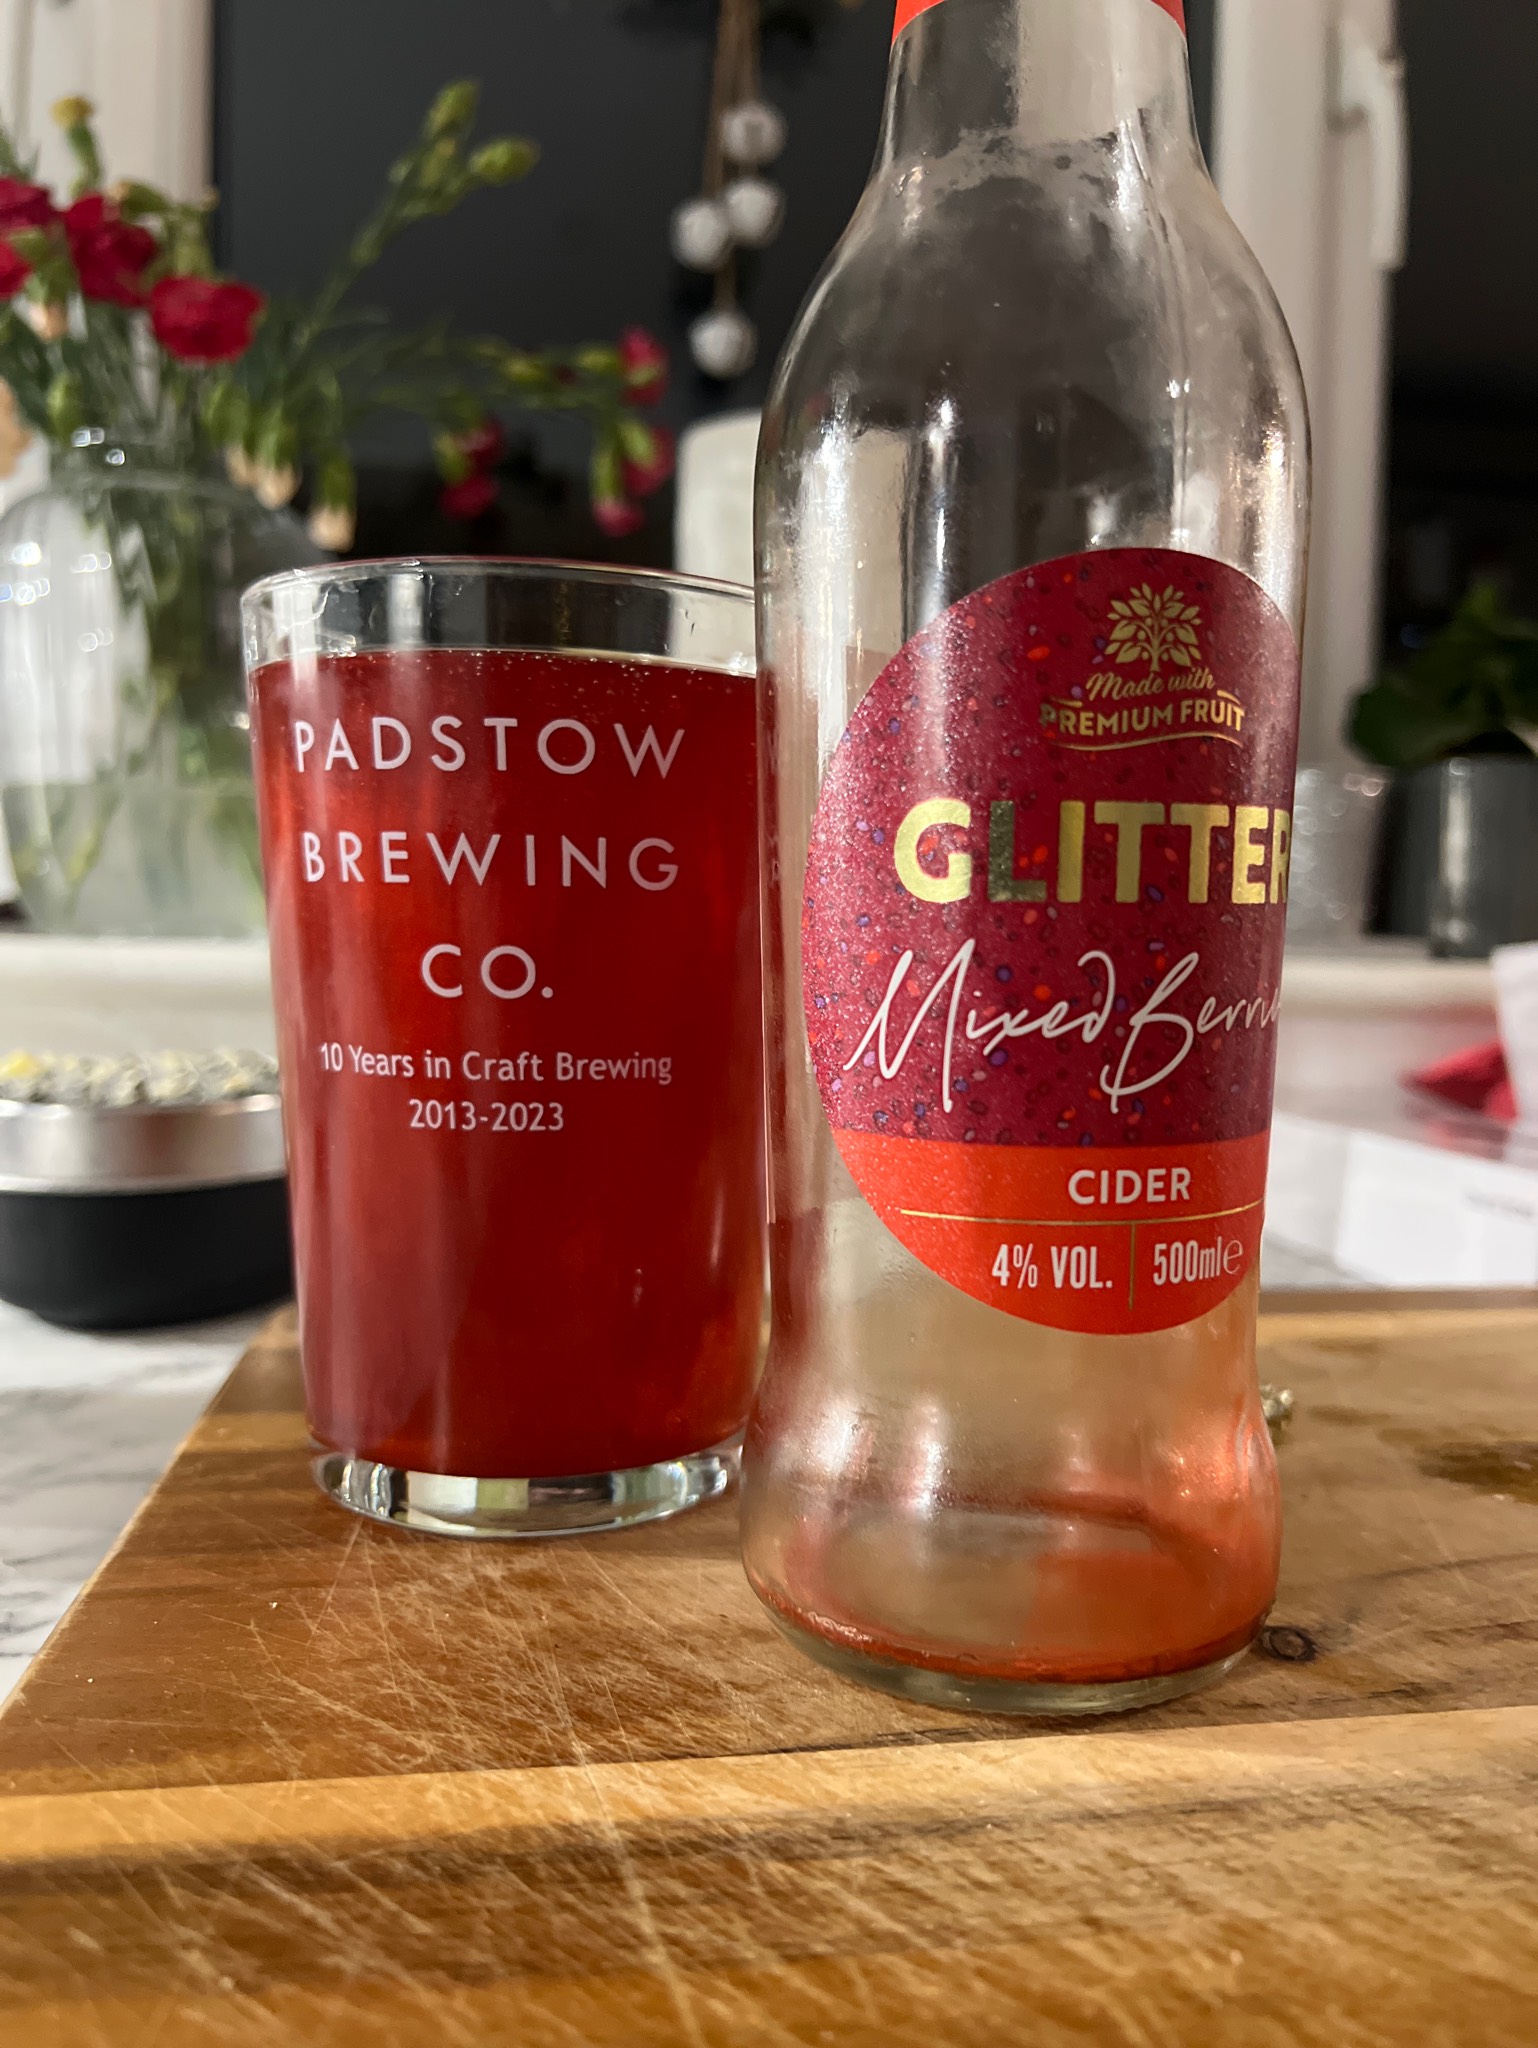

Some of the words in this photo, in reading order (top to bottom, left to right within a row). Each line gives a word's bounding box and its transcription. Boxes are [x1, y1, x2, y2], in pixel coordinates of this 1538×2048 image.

[1086, 671, 1164, 701] Made
[1167, 666, 1216, 692] with
[1039, 702, 1173, 737] PREMIUM
[1180, 699, 1245, 732] FRUIT
[294, 715, 685, 778] PADSTOW
[303, 831, 679, 891] BREWING
[894, 798, 1291, 904] GLITTER
[421, 944, 554, 999] CO.
[843, 938, 1116, 1113] Mixed
[320, 1043, 344, 1072] 10
[349, 1046, 414, 1079] Years
[424, 1050, 450, 1080] in
[463, 1052, 543, 1082] Craft
[556, 1052, 673, 1086] Brewing
[409, 1099, 565, 1132] 2013-2023
[1068, 1167, 1191, 1205] CIDER
[991, 1243, 1039, 1288] 4%
[1051, 1246, 1113, 1289] VOL.
